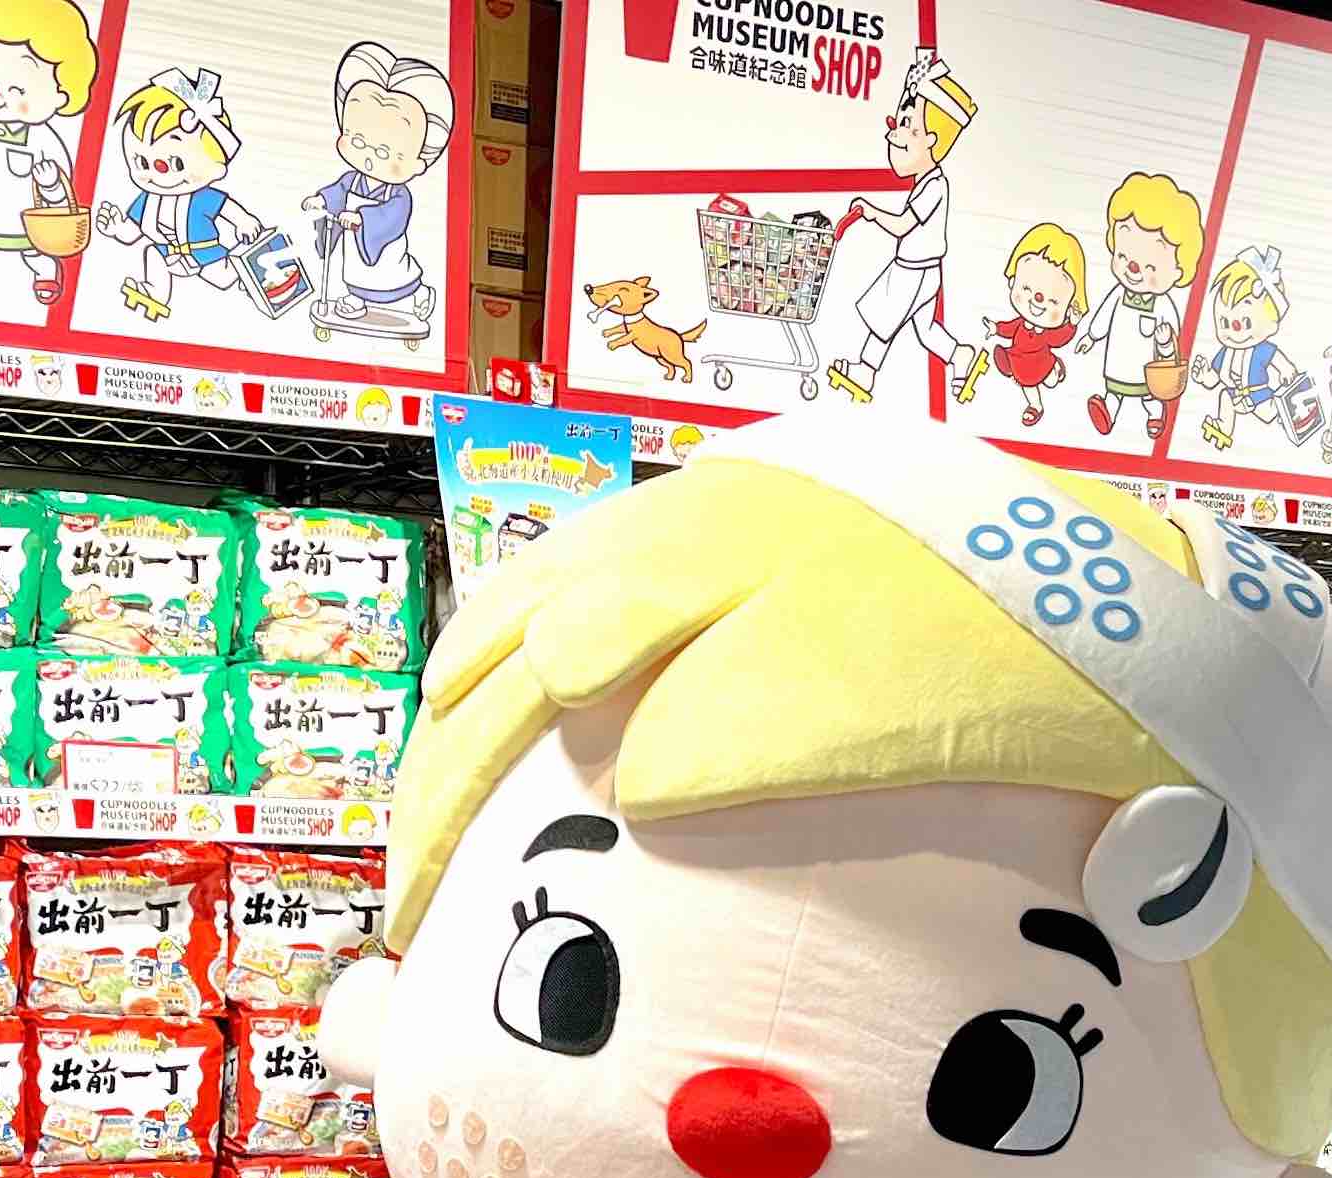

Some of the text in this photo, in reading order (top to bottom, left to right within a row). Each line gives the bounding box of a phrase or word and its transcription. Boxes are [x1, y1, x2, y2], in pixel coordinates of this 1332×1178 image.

[697, 0, 884, 41] PNOODLES
[689, 46, 807, 90] 合味道紀念館
[692, 12, 882, 100] MUSEUM SHOP
[270, 385, 347, 400] CUPNOODLES
[319, 401, 347, 420] SHOP
[73, 540, 210, 585] 出前一丁
[269, 540, 406, 585] 出前一丁
[53, 688, 194, 724] 出前一丁
[265, 698, 395, 736] 出前一丁
[38, 894, 181, 935] 出前一丁
[242, 890, 385, 934] 出前一丁
[51, 1057, 189, 1096] 出前一丁
